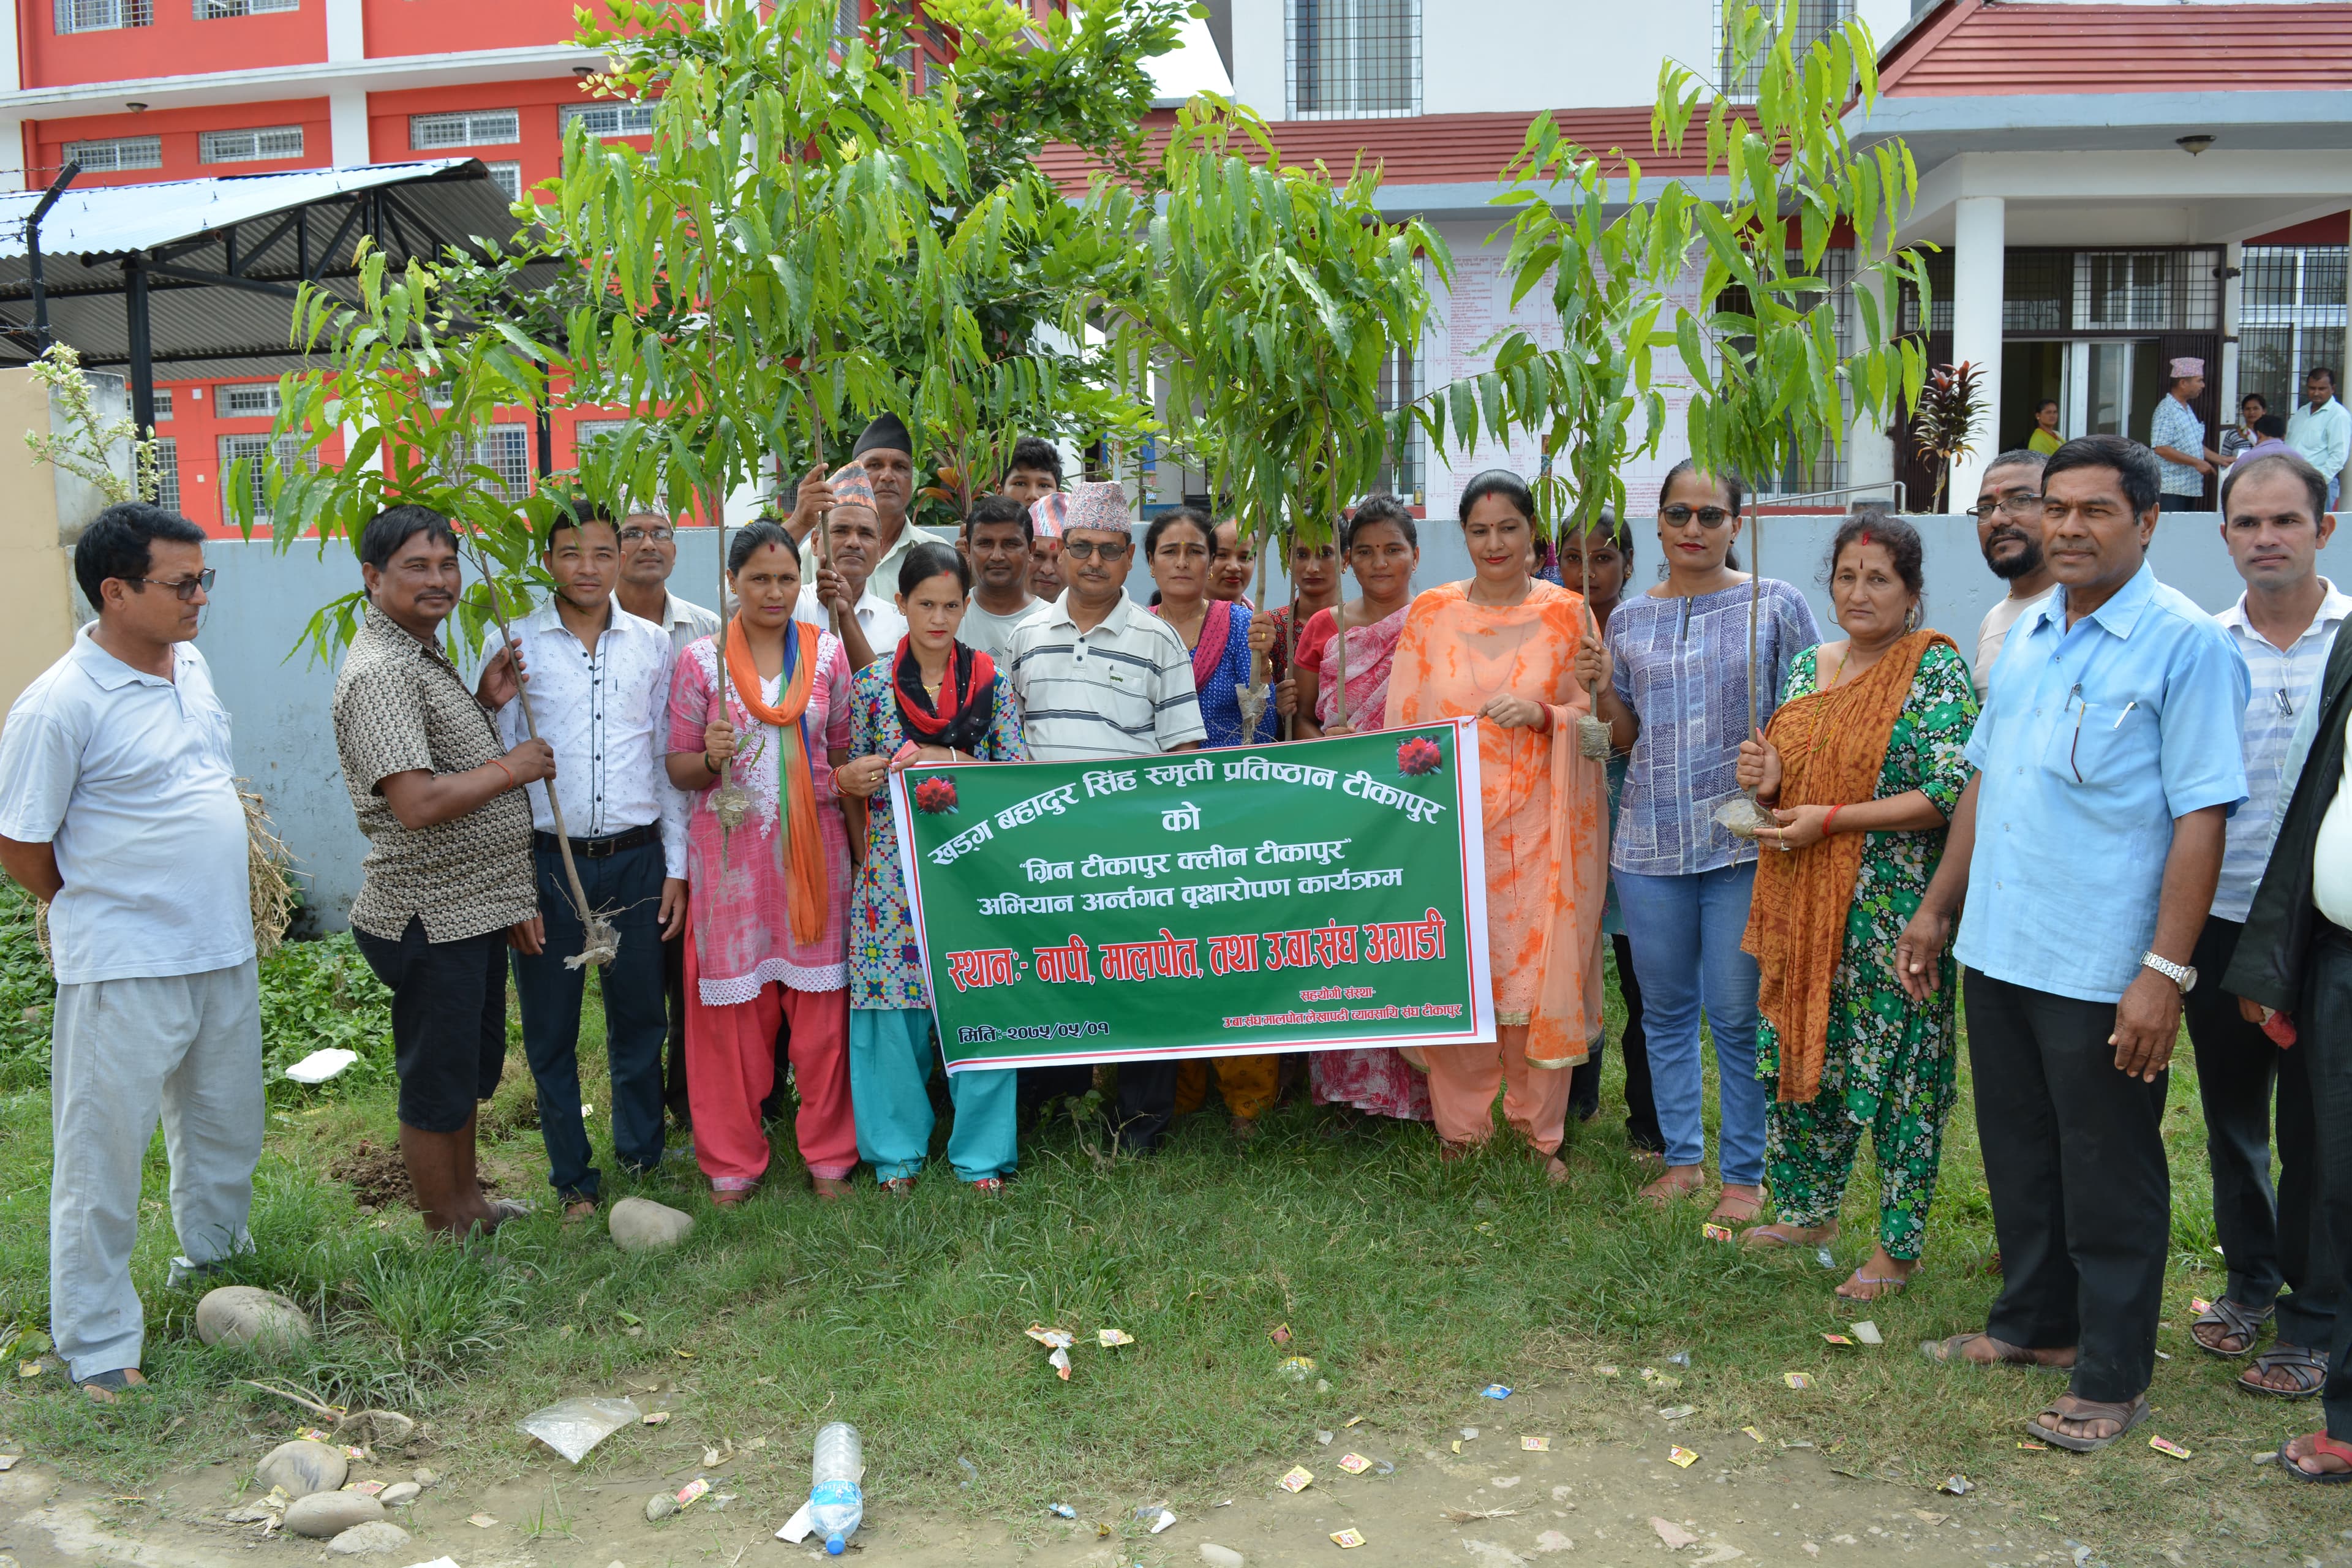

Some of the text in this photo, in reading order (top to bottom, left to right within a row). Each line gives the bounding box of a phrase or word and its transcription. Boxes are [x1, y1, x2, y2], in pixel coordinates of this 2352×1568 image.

[995, 783, 1079, 829] बहादुर
[1083, 770, 1137, 797] सिंह
[1145, 759, 1215, 787] स्मृती
[1224, 756, 1338, 790] प्रतिष्ठान
[1343, 770, 1446, 824] टीकापुर
[1161, 800, 1201, 831] को
[1081, 854, 1170, 878] टीकापुर
[1177, 844, 1248, 870] क्लीन
[977, 892, 1074, 915] अभियान
[1182, 876, 1291, 909] वृक्षारोपण
[1298, 868, 1403, 894] कार्यक्रम
[1033, 934, 1096, 986] नापी,
[1098, 928, 1204, 982] मालपोत,
[1207, 933, 1259, 976] तथा
[1362, 907, 1447, 964] अगाडी
[1300, 986, 1342, 1002] सहयोगी
[1401, 1005, 1420, 1019] संघ
[1422, 1003, 1463, 1019] टीकापुर
